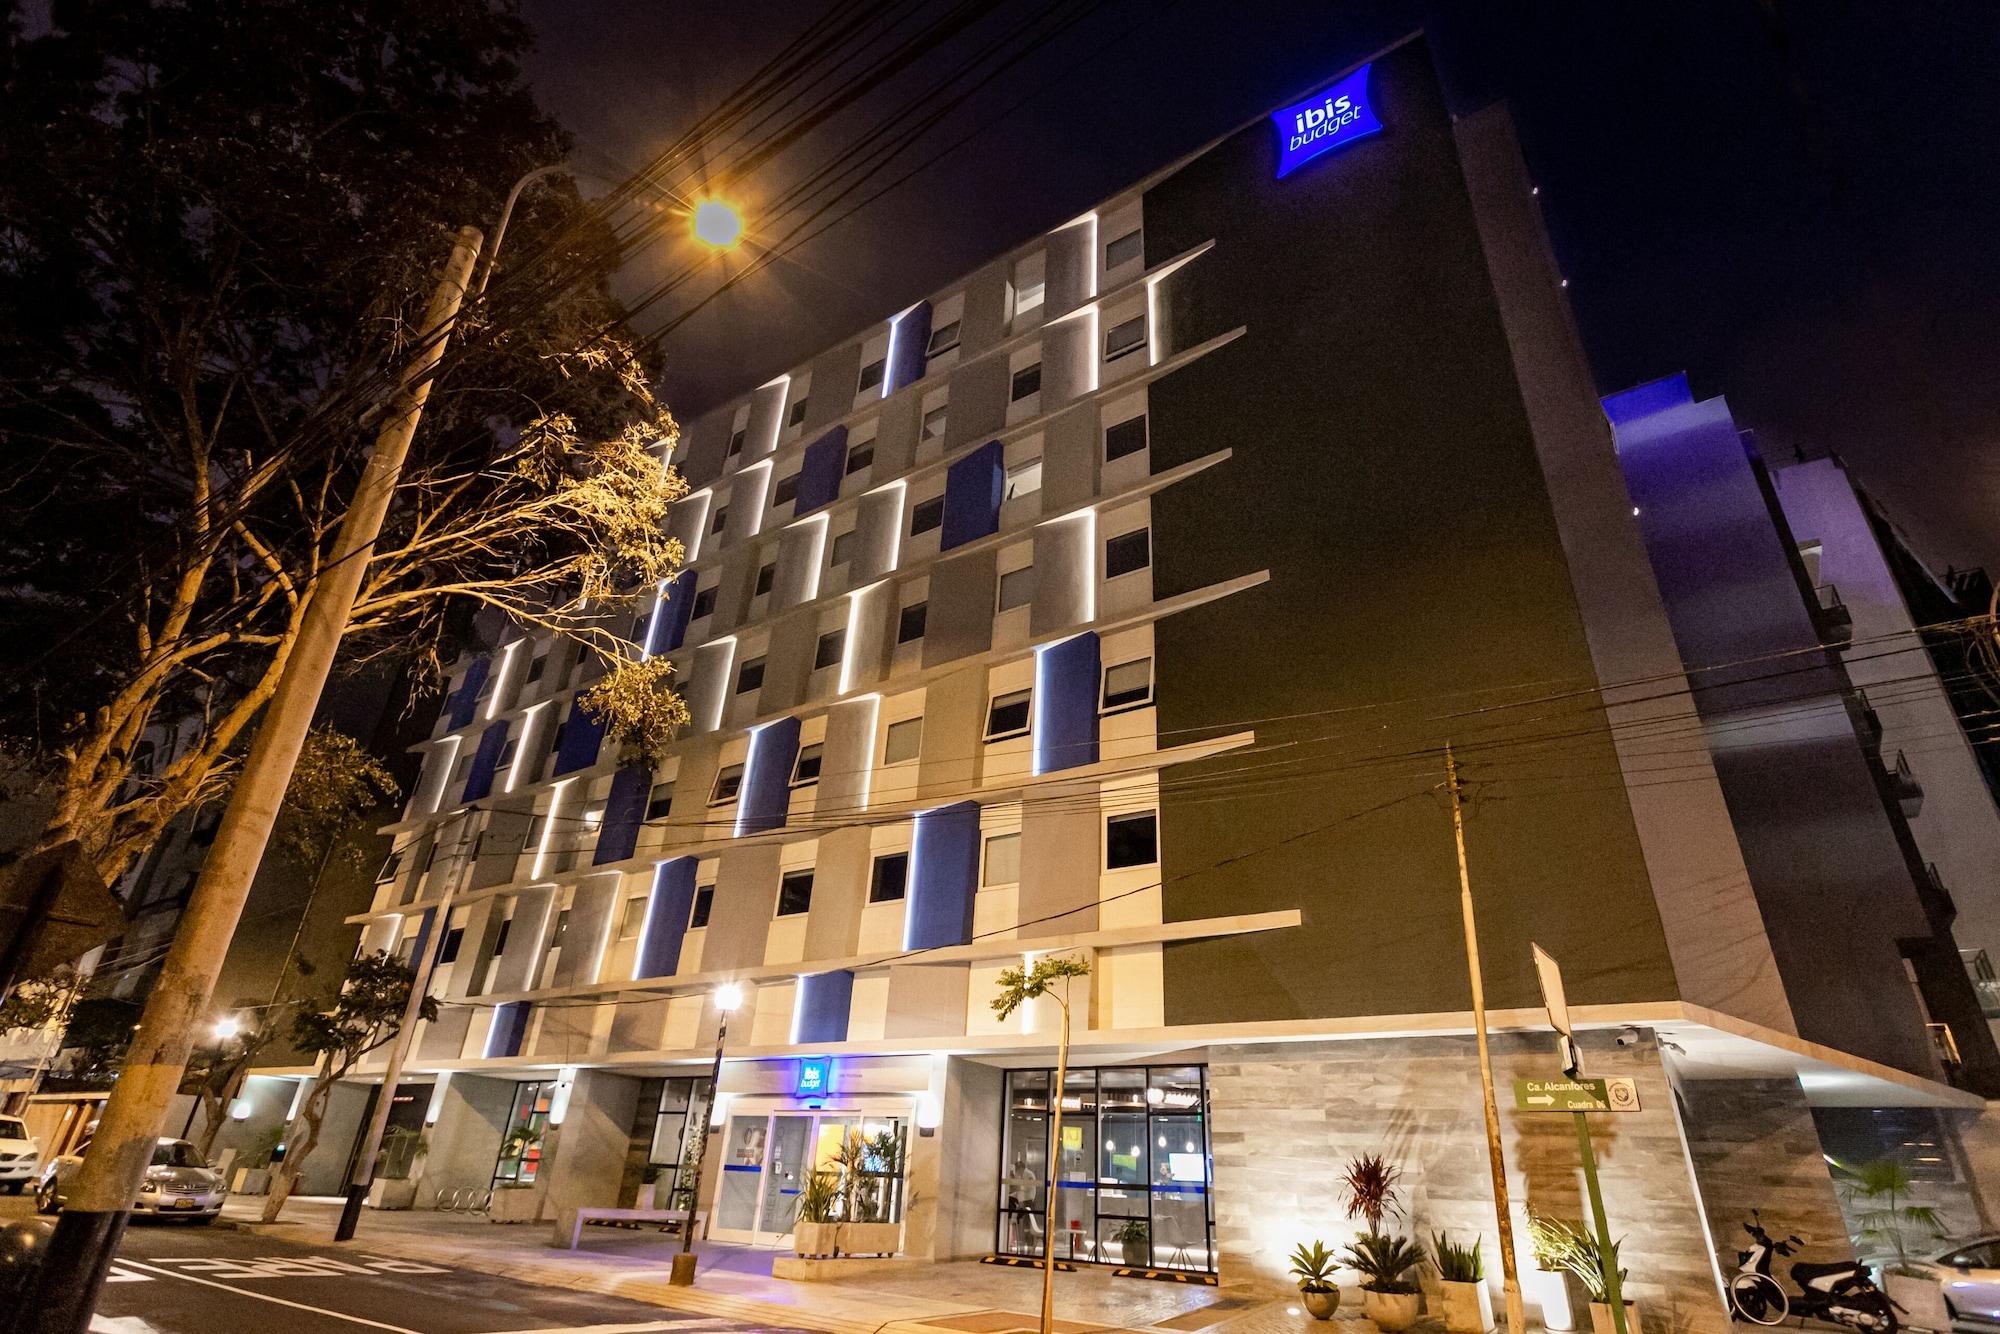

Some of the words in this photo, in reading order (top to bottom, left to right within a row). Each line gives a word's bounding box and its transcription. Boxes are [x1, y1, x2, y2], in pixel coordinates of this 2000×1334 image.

[1296, 95, 1351, 133] ibis
[1289, 105, 1361, 152] budget
[804, 1067, 820, 1080] ibis
[800, 1079, 821, 1090] budget
[1527, 1082, 1543, 1092] Ca.
[1544, 1081, 1596, 1092] Alcanfores
[1567, 1100, 1594, 1109] Cuadra
